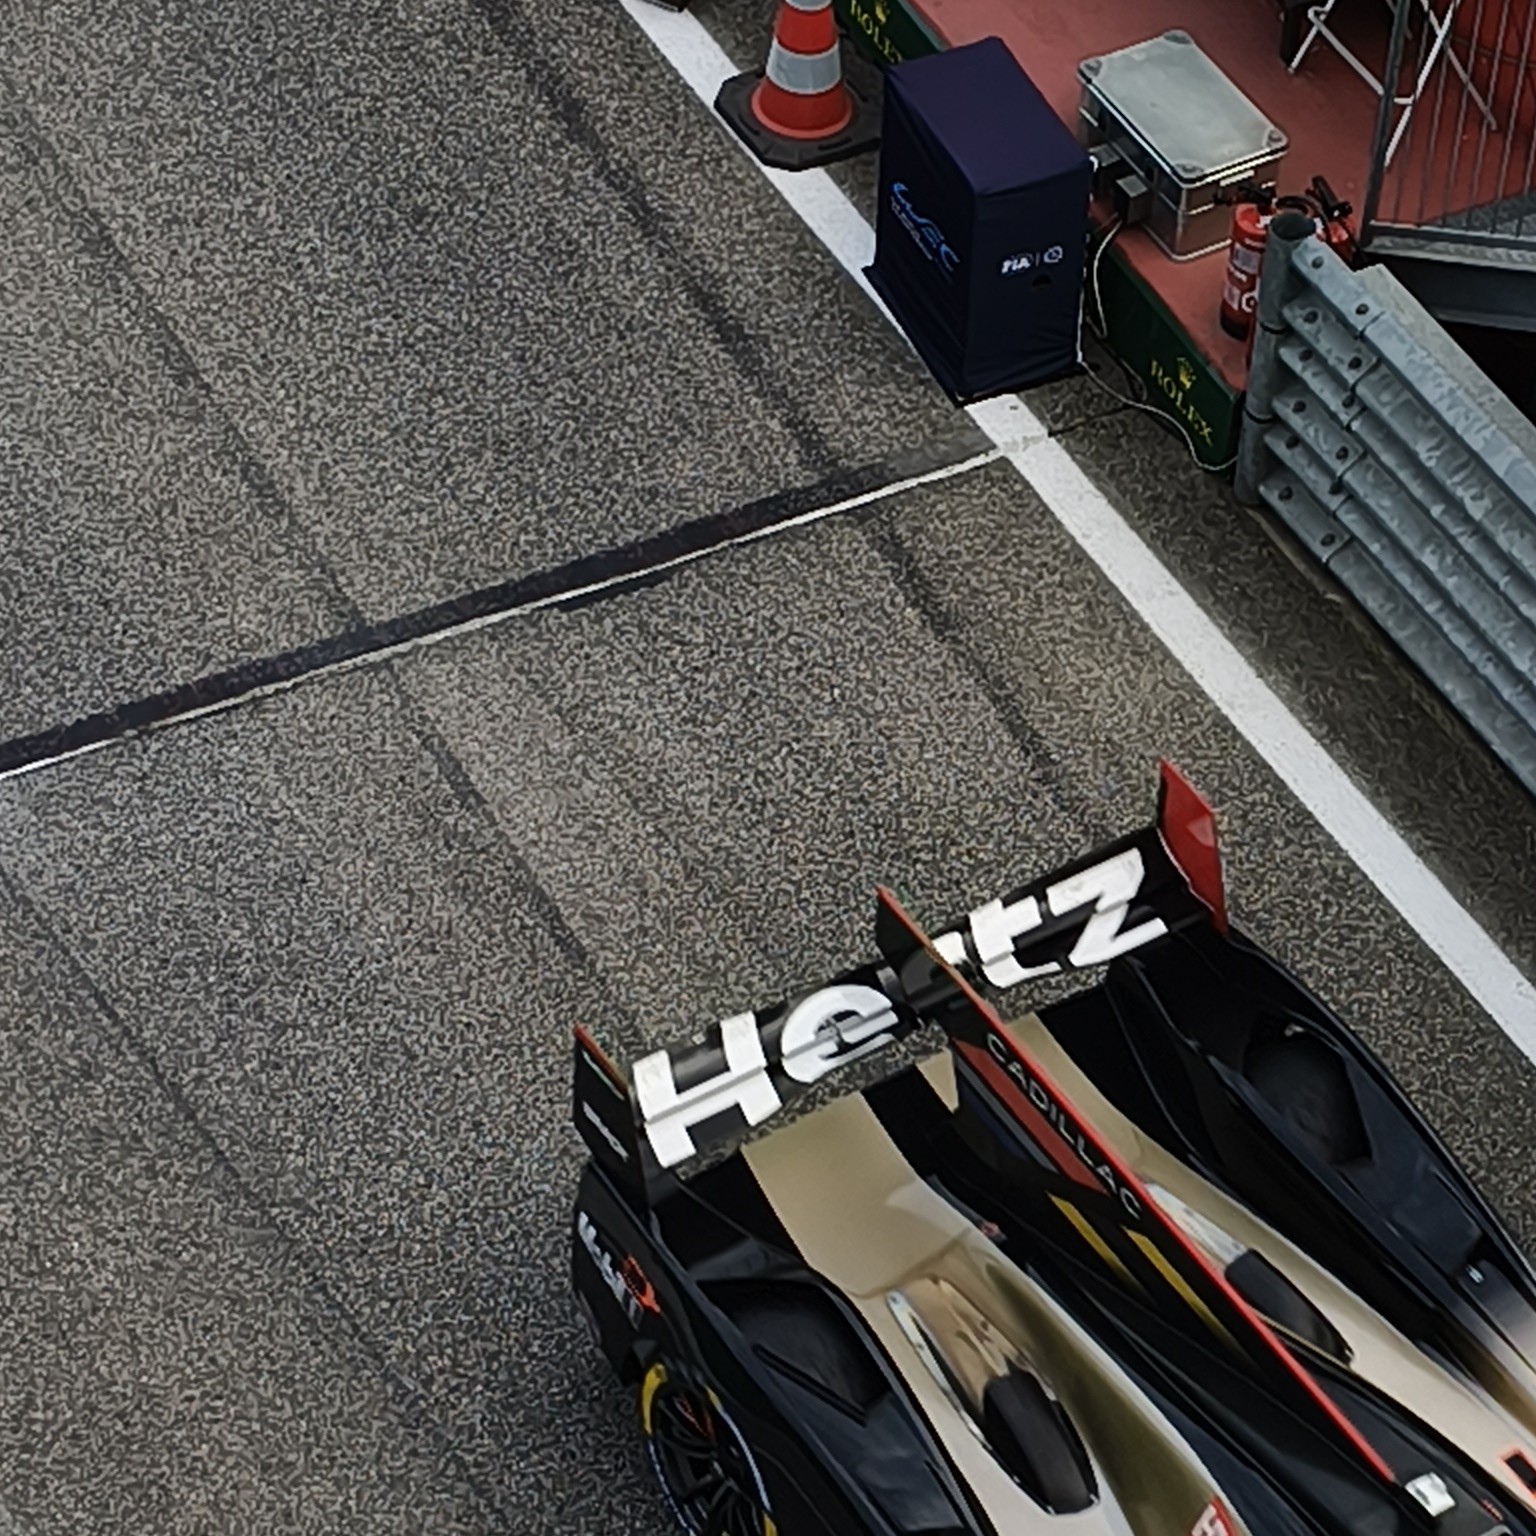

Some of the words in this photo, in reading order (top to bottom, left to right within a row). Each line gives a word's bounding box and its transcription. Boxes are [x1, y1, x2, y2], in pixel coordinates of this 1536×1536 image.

[849, 0, 903, 64] ROLE
[1150, 359, 1213, 447] ROLEX
[987, 1032, 1142, 1220] CADILLAC
